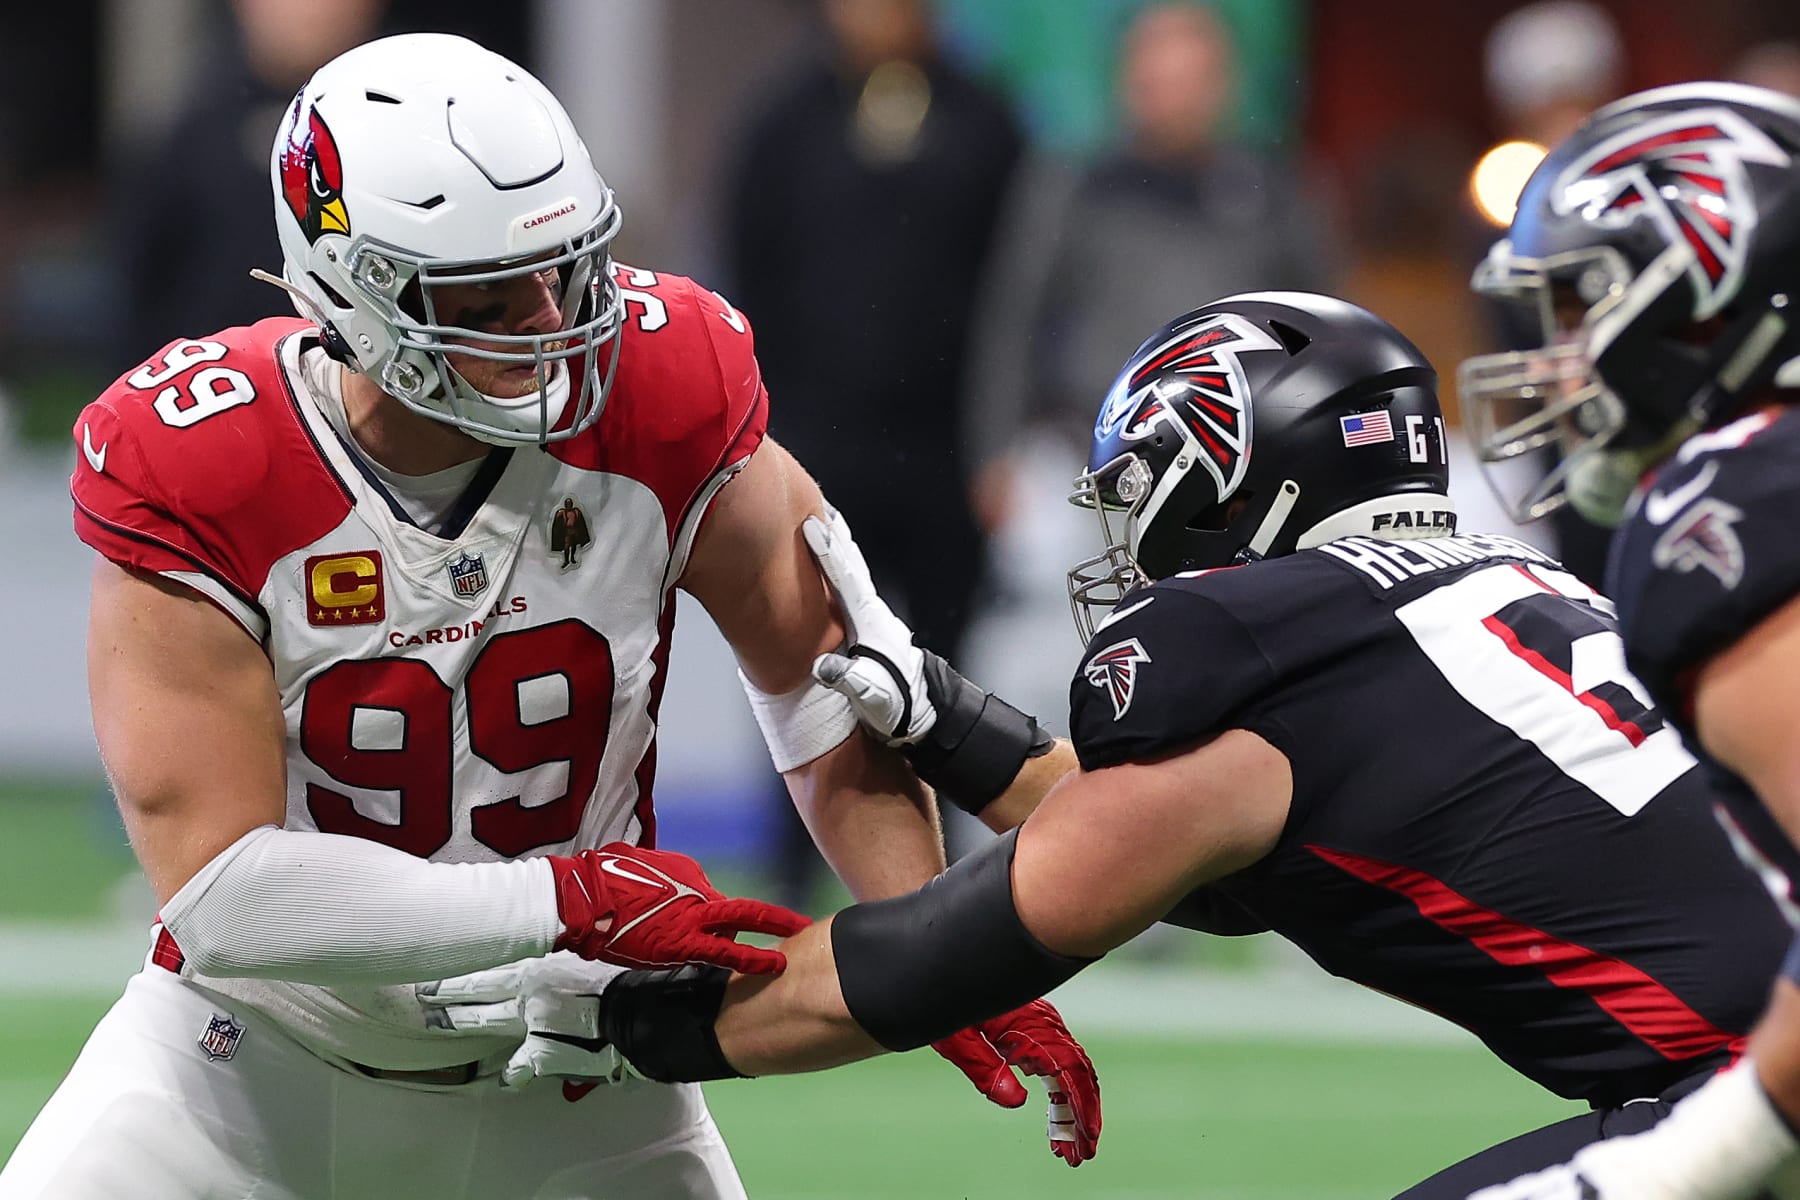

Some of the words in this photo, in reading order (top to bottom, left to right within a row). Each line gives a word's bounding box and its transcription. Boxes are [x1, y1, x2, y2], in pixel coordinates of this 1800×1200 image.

[523, 203, 576, 230] CARDINALS
[128, 340, 256, 427] 99
[1405, 415, 1446, 465] 61
[311, 557, 378, 608] C
[300, 618, 615, 860] 99
